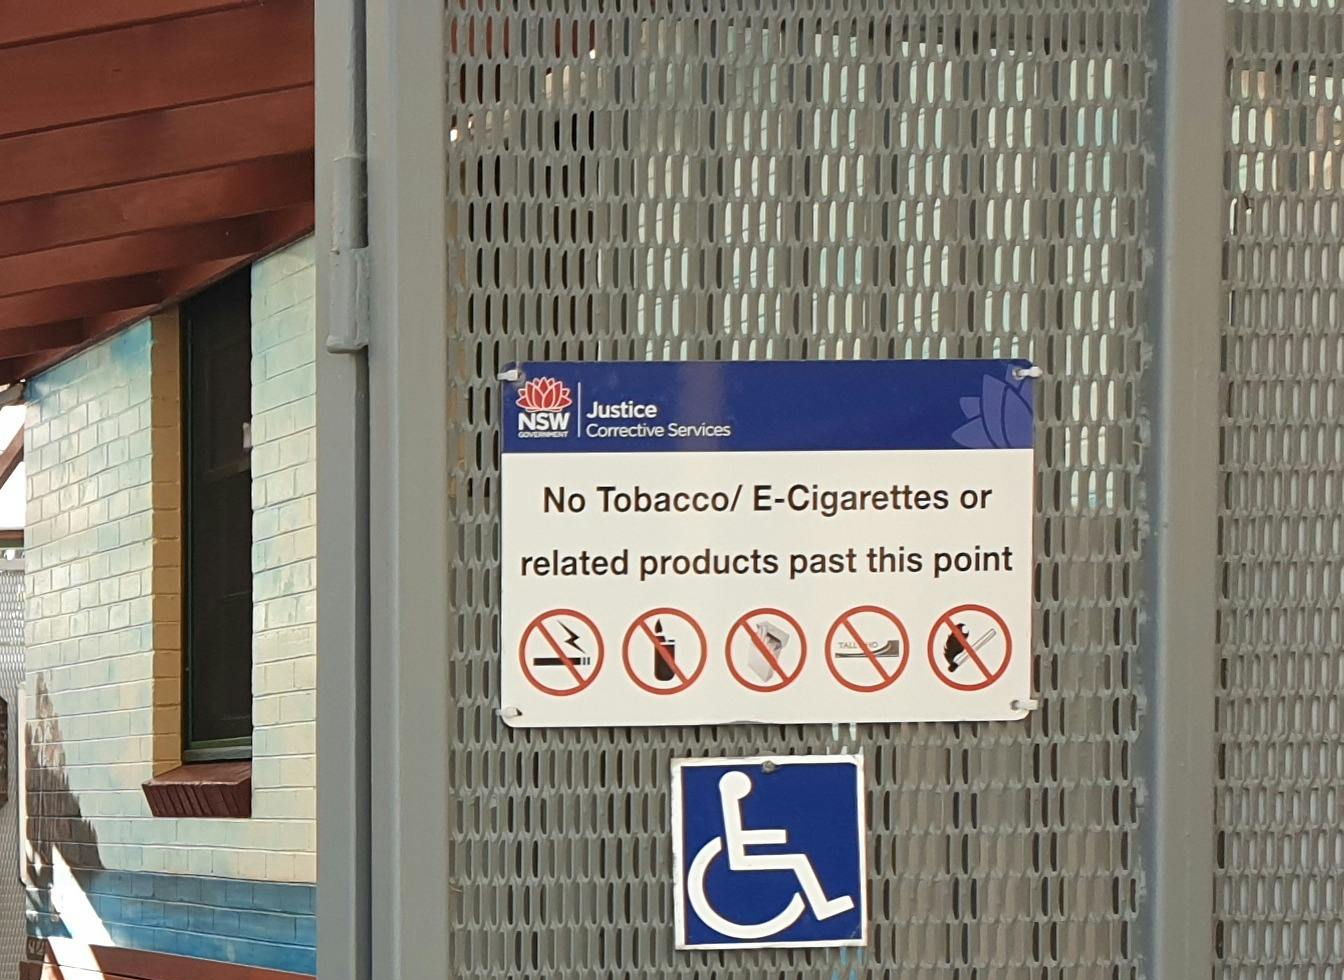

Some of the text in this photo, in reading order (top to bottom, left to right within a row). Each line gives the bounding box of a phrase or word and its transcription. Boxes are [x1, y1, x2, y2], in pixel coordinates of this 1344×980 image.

[586, 401, 657, 418] Justice
[519, 412, 570, 432] NSW
[586, 423, 731, 437] Corrective Services
[544, 484, 992, 514] No Tobacco/ E-Cigarettes or
[522, 545, 1012, 579] related products past this point
